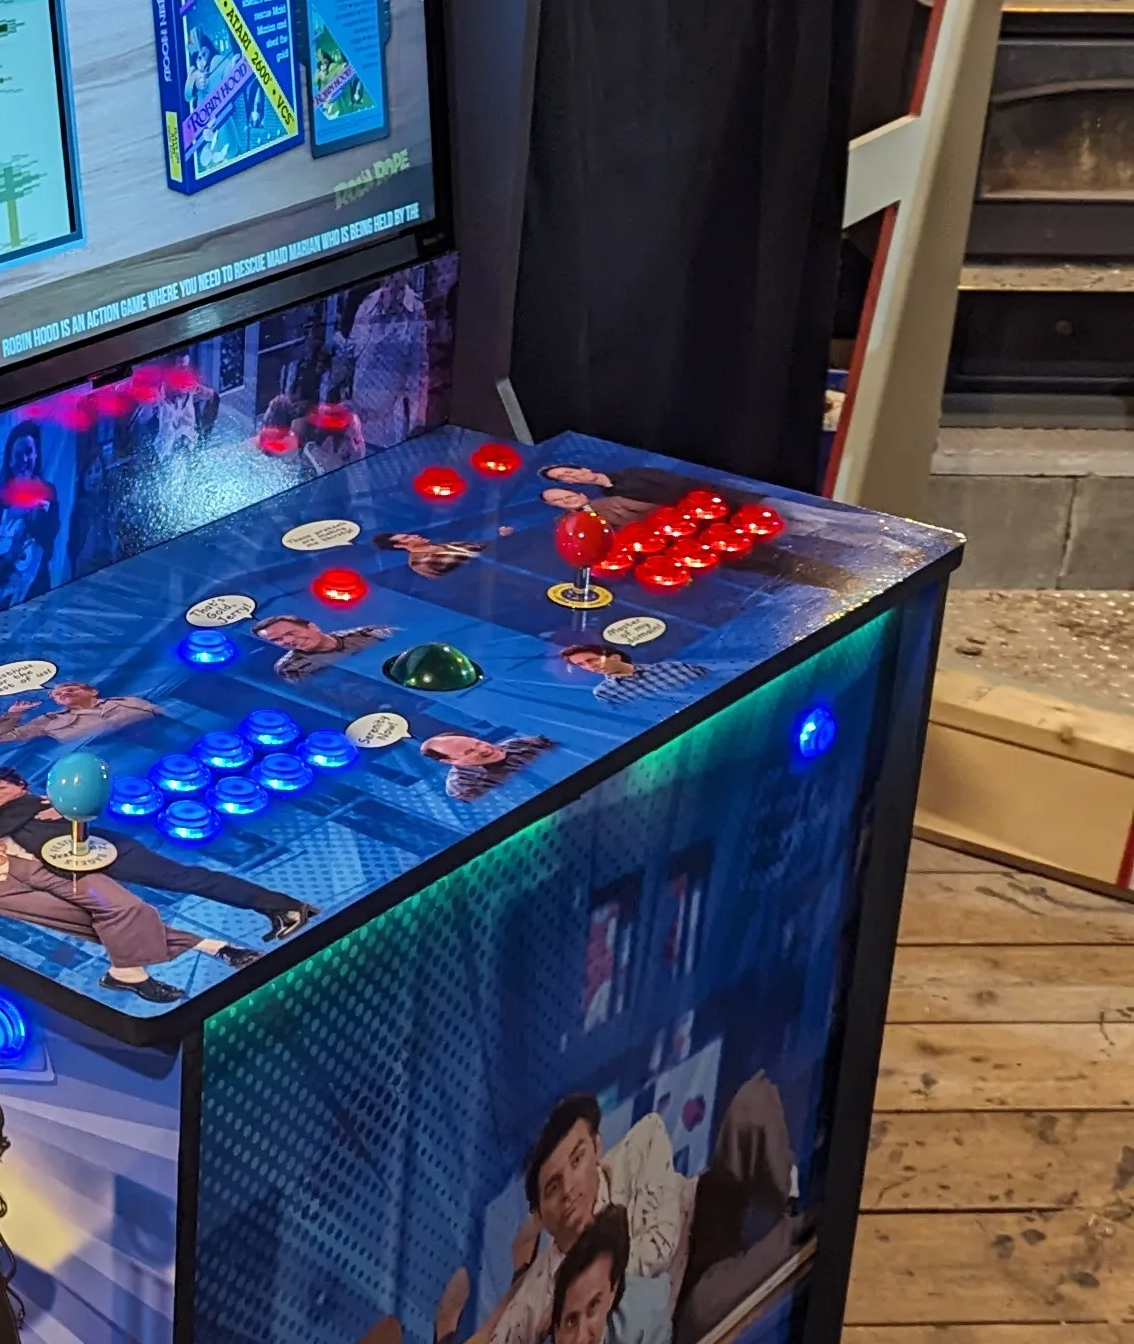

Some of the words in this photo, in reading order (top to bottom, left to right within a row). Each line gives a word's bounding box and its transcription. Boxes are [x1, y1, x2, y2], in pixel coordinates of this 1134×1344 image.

[187, 91, 221, 133] ROBIN
[221, 62, 248, 99] HOOD
[226, 8, 251, 51] ATARI
[251, 51, 272, 86] 2600
[276, 95, 295, 126] VCS
[1, 334, 32, 358] ROBIN
[33, 325, 59, 347] HOOD
[61, 321, 71, 339] IS
[72, 315, 86, 334] AN
[87, 304, 120, 329] ACTION
[120, 295, 146, 317] GAME
[147, 286, 179, 309] WHERE
[180, 278, 198, 298] YOU
[198, 271, 221, 292] NEED
[221, 266, 233, 284] TO
[234, 253, 265, 279] RESCUE
[266, 246, 288, 269] MAID
[288, 235, 321, 263] MARIAN
[321, 228, 341, 250] WHO
[341, 225, 349, 244] IS
[350, 217, 373, 241] BEING
[373, 210, 393, 233] HELD
[394, 207, 405, 227] BY
[405, 203, 420, 222] THE
[189, 598, 225, 617] That's
[217, 602, 252, 624] Jerry!
